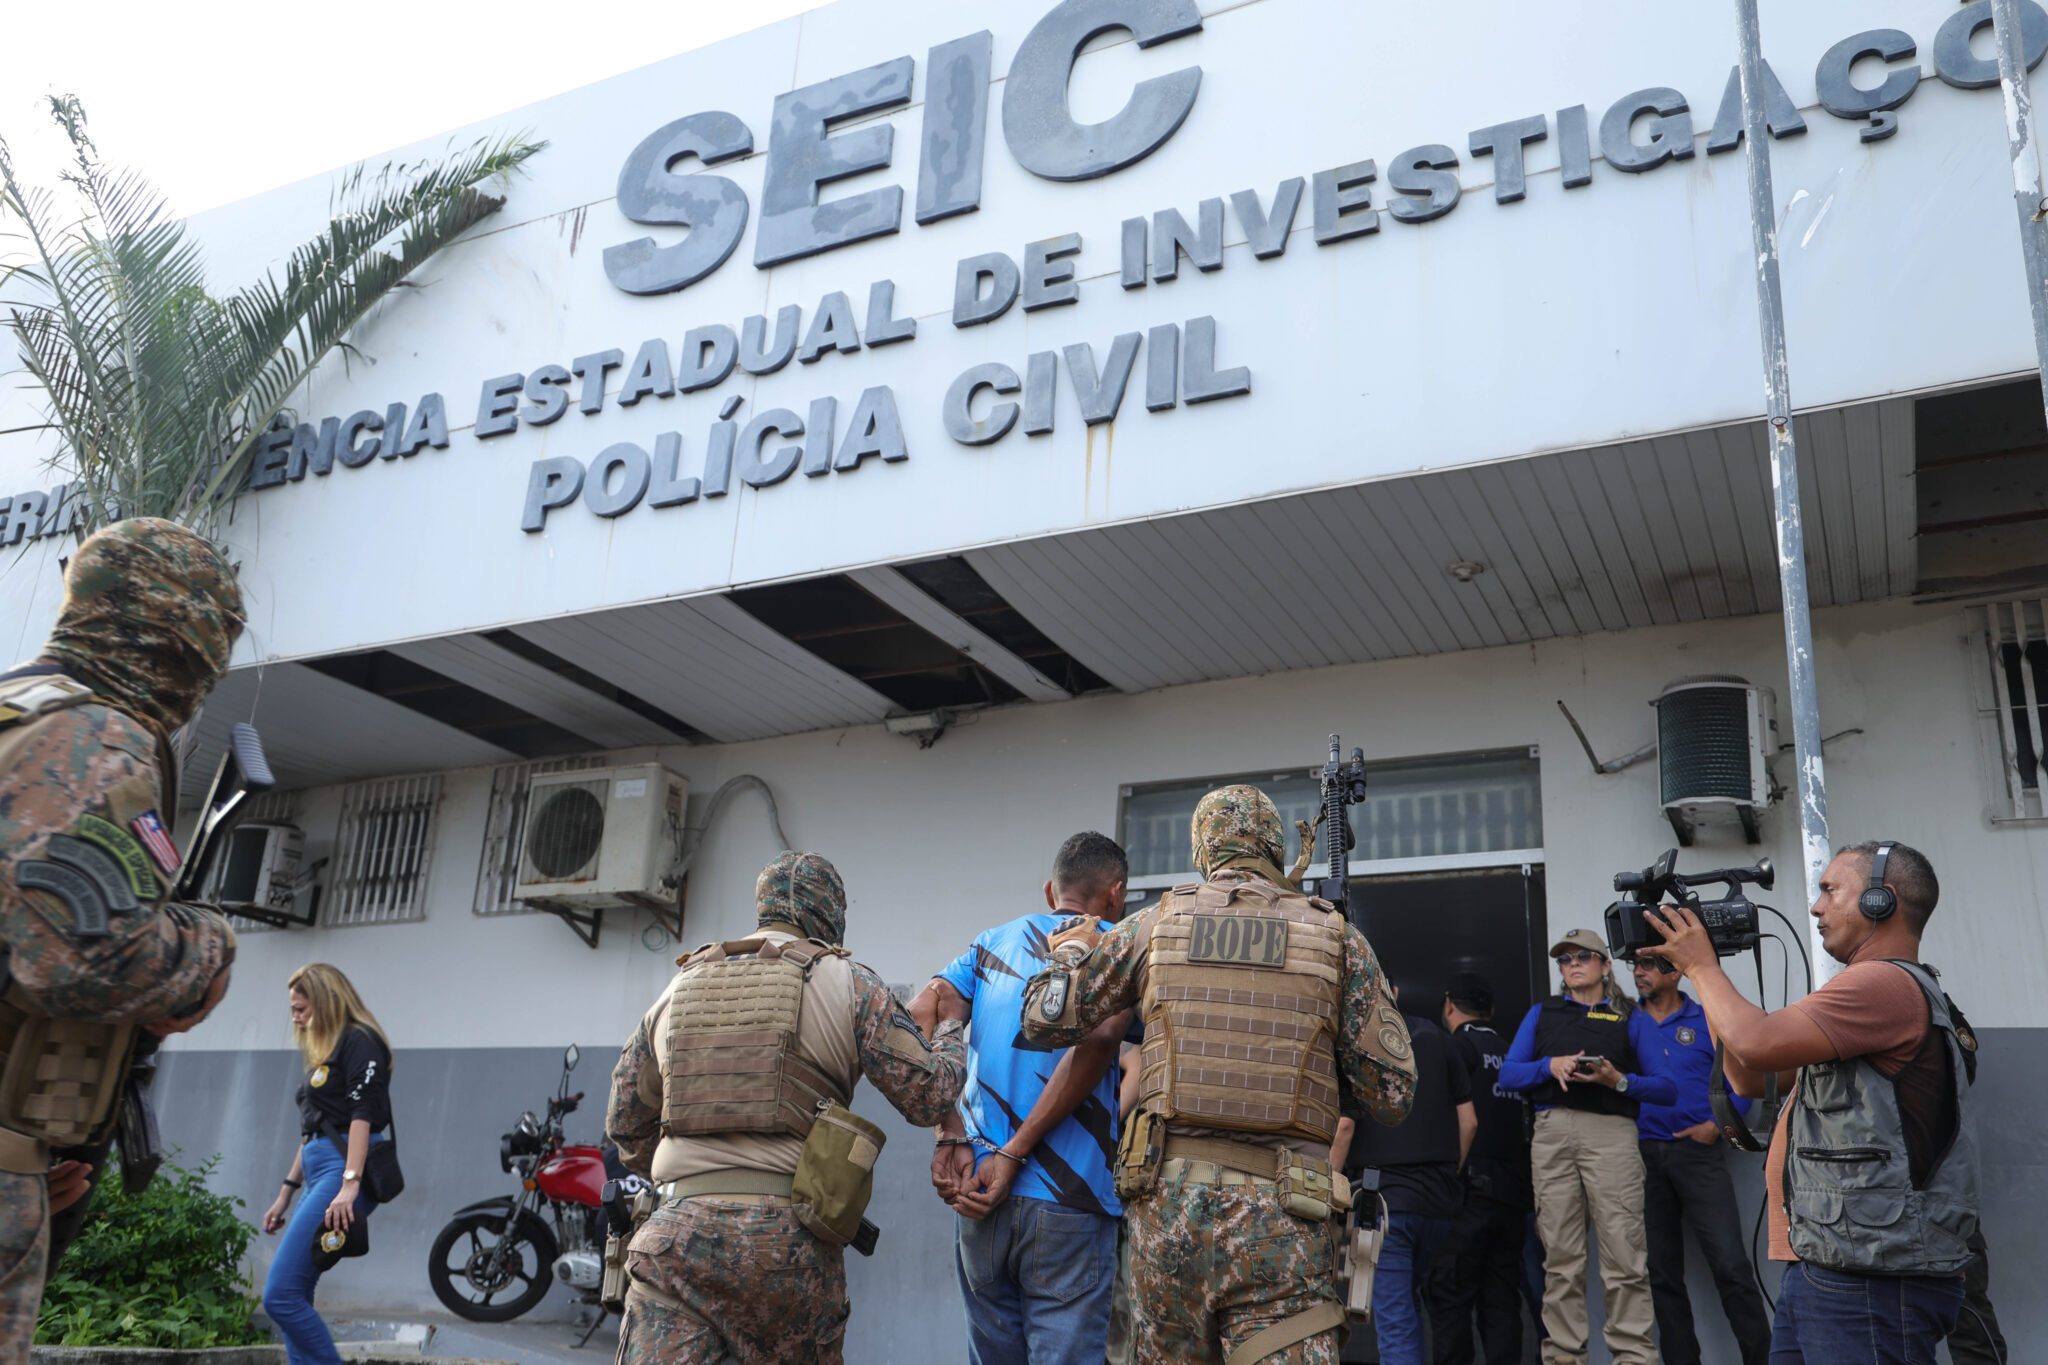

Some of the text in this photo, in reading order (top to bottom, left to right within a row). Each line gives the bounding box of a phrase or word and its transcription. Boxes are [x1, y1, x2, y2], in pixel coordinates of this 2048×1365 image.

[602, 0, 1204, 296] SEIC
[474, 278, 917, 441] ESTADUAL
[952, 232, 1082, 329] DE
[521, 314, 1253, 535] POLÍCIA CIVIL
[1191, 917, 1286, 964] BOPE
[1866, 895, 1886, 906] JBL
